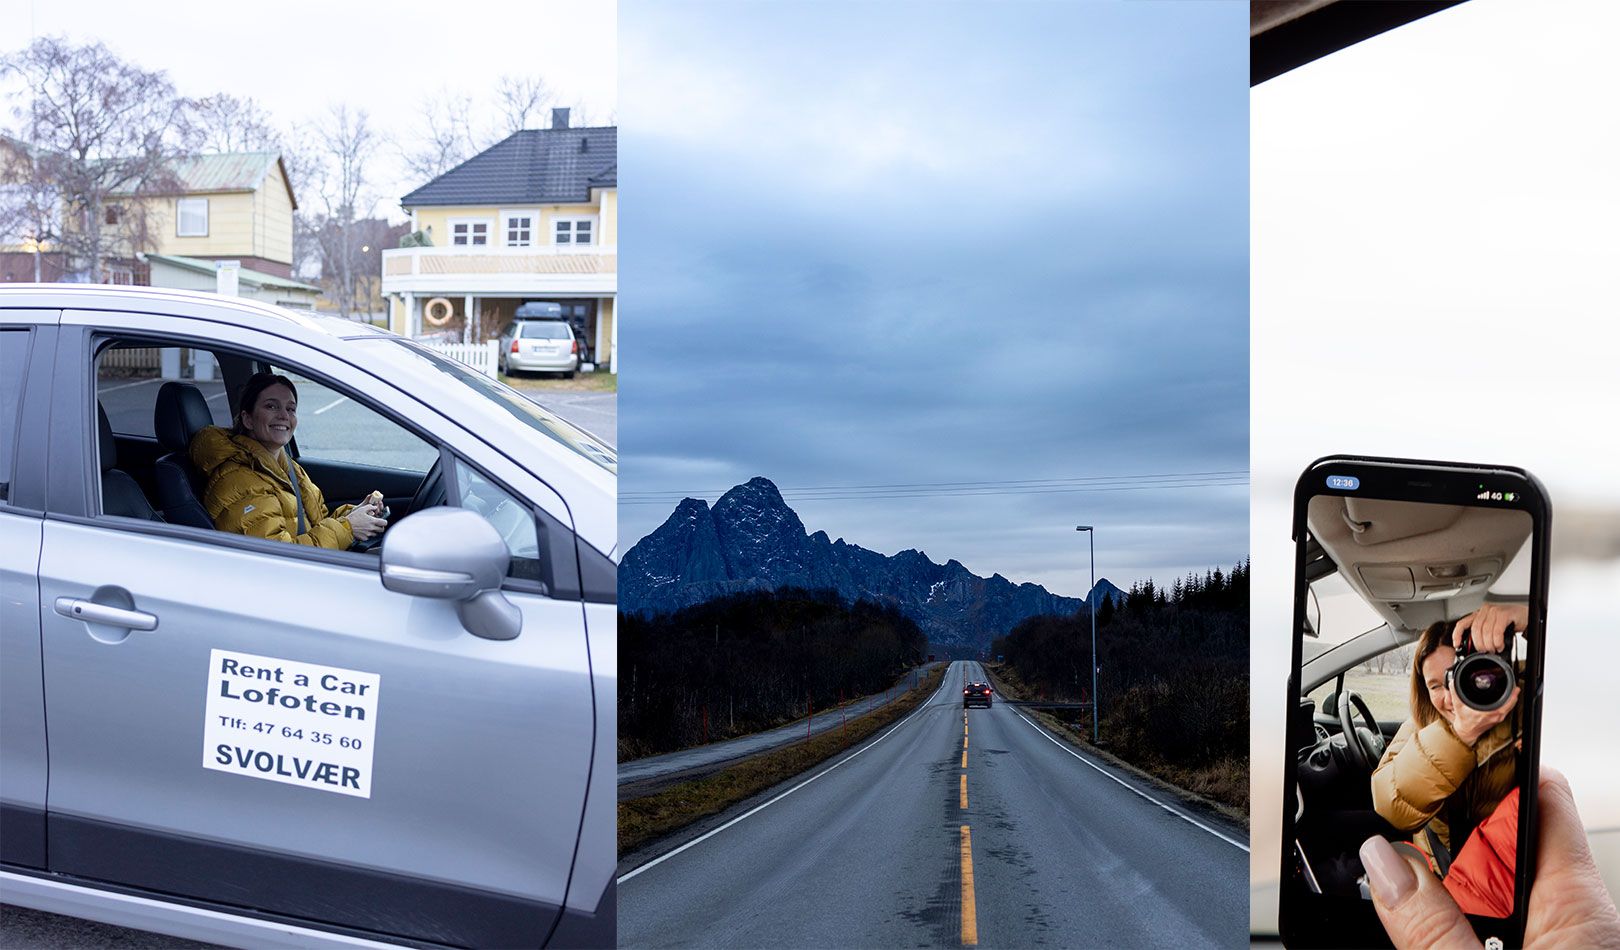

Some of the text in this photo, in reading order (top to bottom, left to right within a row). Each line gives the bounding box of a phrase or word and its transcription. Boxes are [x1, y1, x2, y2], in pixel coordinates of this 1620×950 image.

[1490, 492, 1503, 501] 4G
[221, 658, 370, 696] Rent a Car
[220, 680, 366, 721] Lofoten
[219, 715, 362, 750] Tlf: 47 64 35 60
[216, 744, 361, 790] SVOLVÆR
